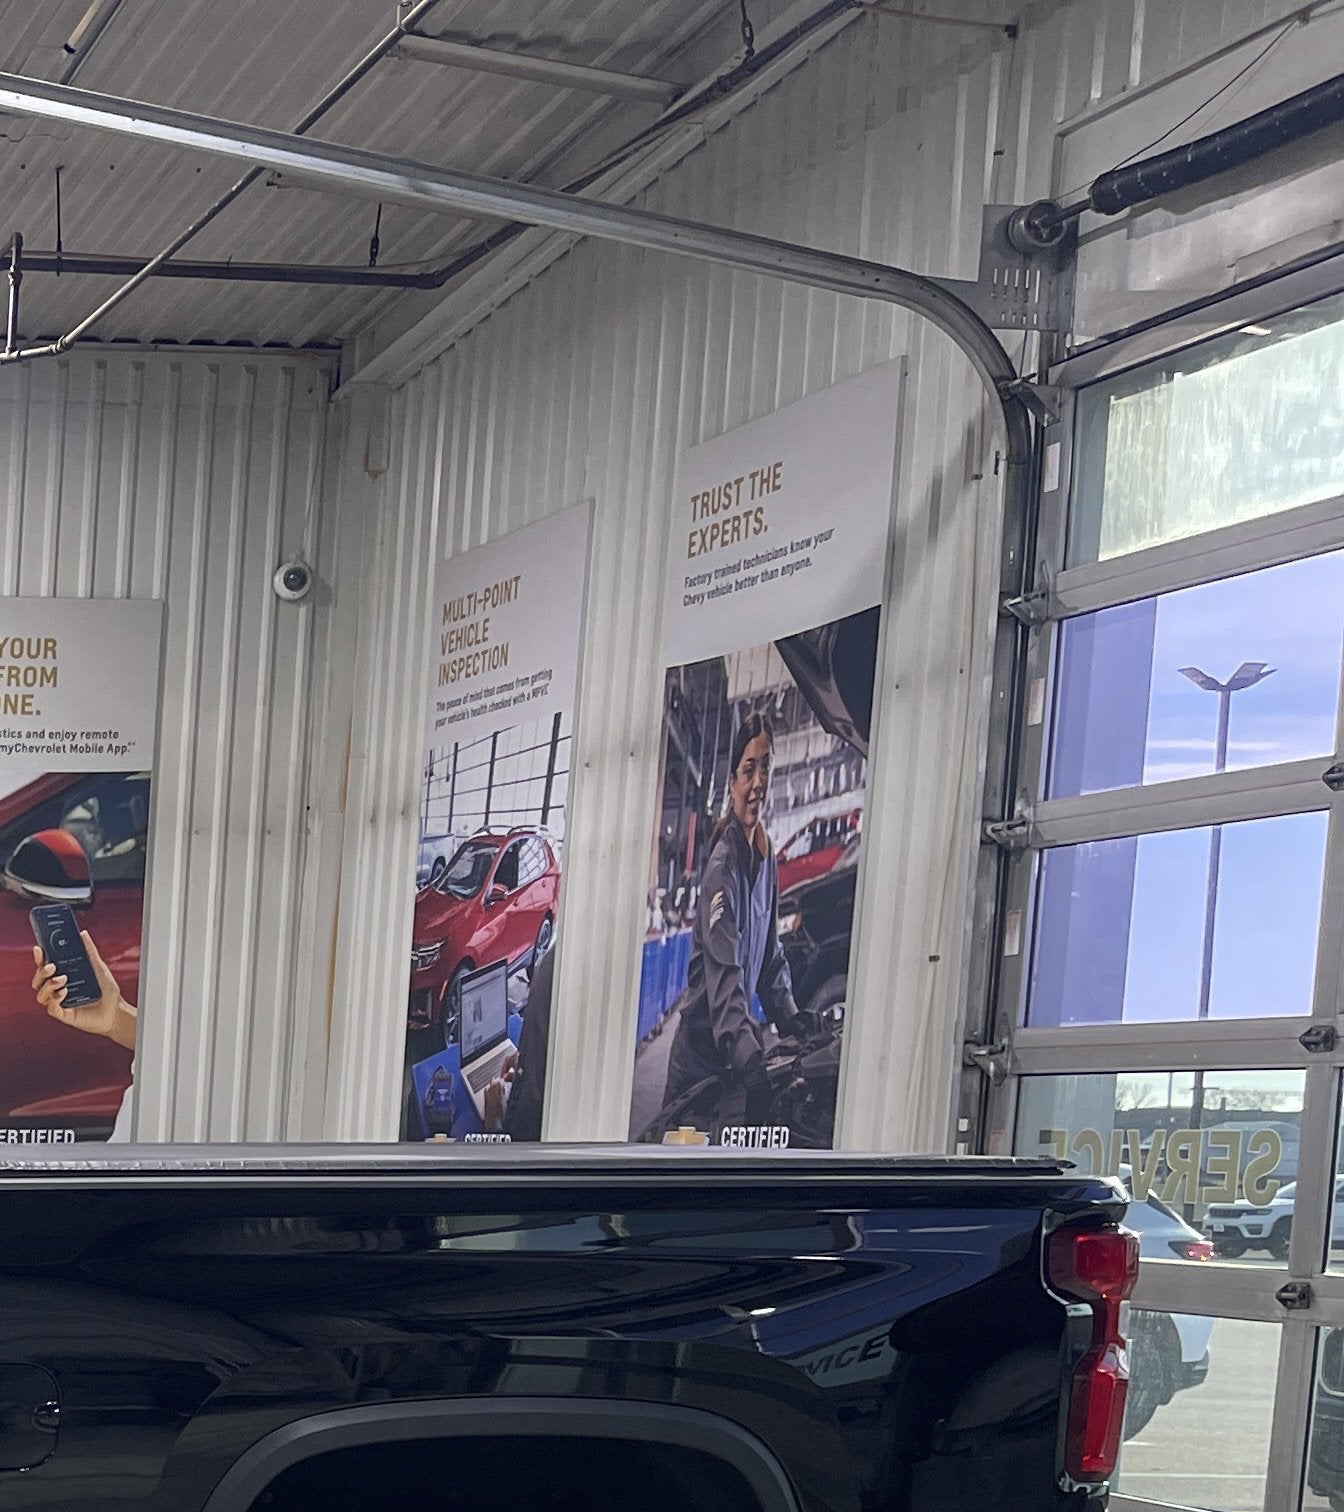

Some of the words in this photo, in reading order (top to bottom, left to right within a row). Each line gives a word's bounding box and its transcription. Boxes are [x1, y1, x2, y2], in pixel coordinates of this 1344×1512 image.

[691, 476, 745, 523] TRUST
[749, 461, 783, 500] THE
[687, 506, 769, 559] EXPERTS.
[684, 571, 713, 589] Factory
[714, 559, 742, 580] trained
[743, 546, 788, 570] technicians
[790, 537, 812, 553] know
[813, 528, 835, 549] your
[442, 575, 521, 626] MULTI-POINT
[683, 592, 706, 606] Chevy
[707, 582, 733, 600] vehicle
[734, 573, 760, 592] better
[761, 567, 779, 583] than
[440, 618, 490, 656] VEHICLE
[438, 642, 509, 687] INSPECTION
[25, 729, 45, 739] and
[48, 729, 77, 742] enjoy
[80, 730, 119, 739] remote
[70, 743, 104, 753] Mobile
[721, 1126, 790, 1148] CERTIFIED
